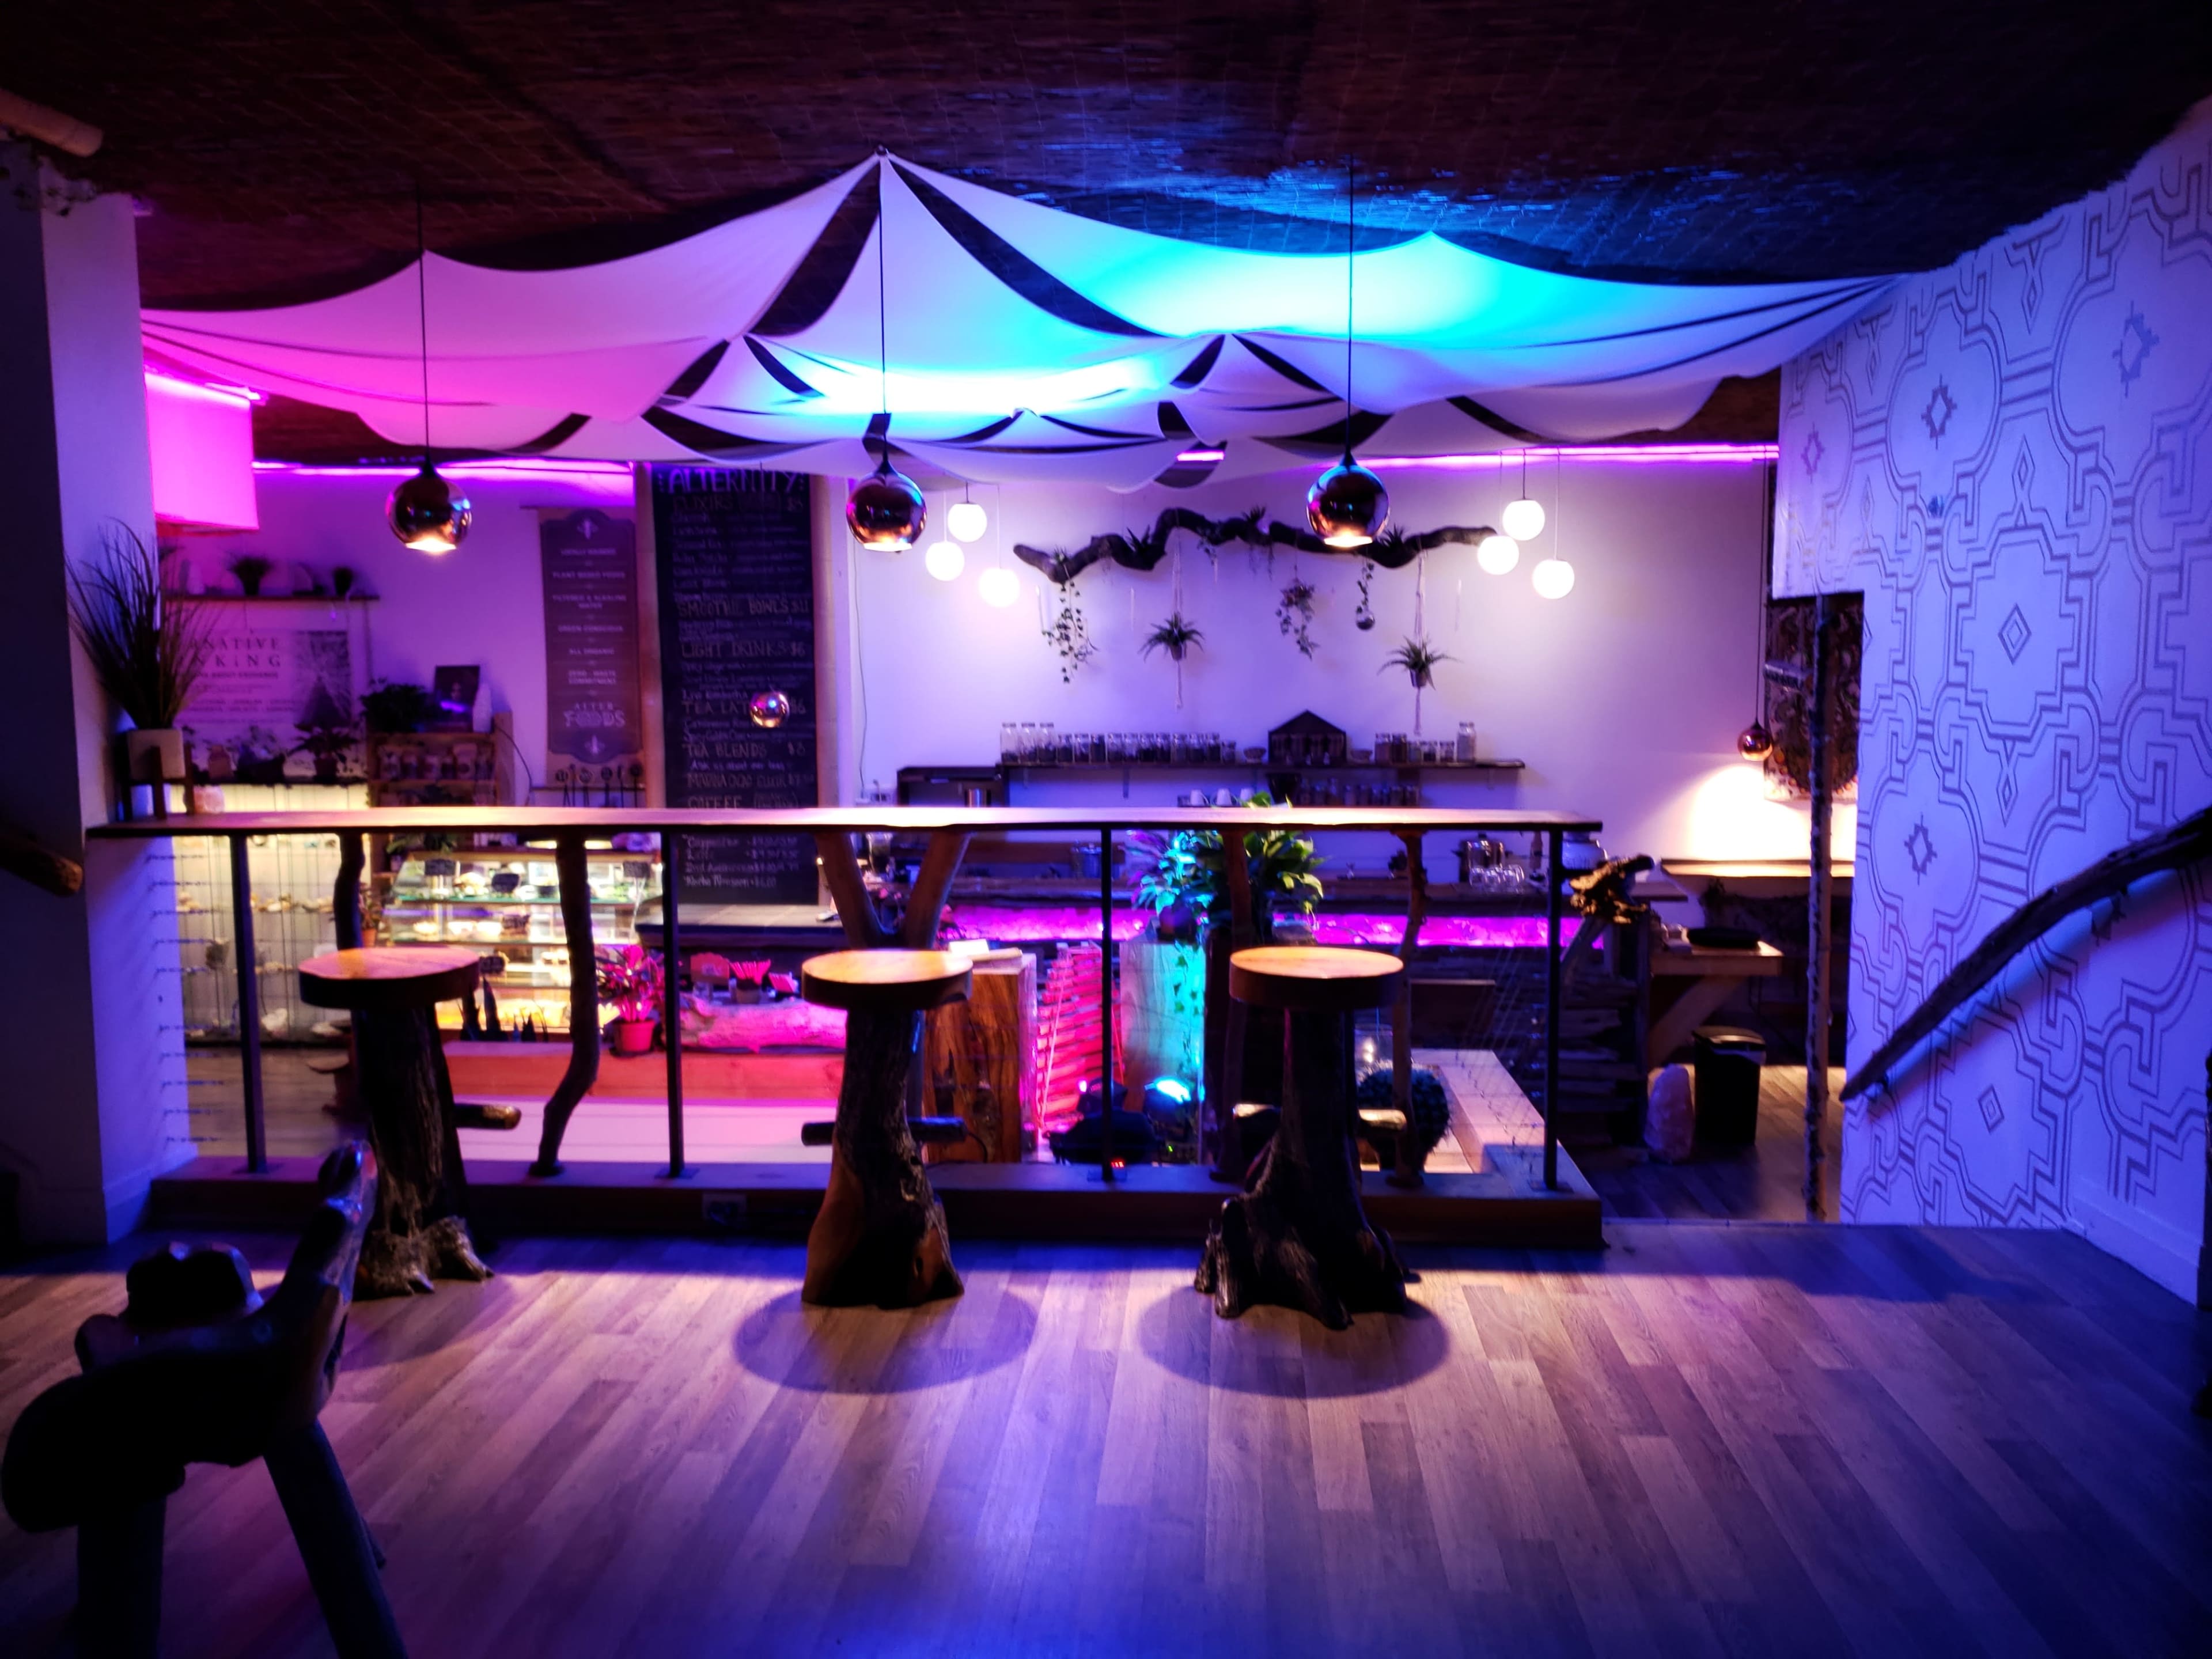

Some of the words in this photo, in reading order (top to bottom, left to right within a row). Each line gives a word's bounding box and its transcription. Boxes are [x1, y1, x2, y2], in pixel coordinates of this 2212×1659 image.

[668, 468, 796, 494] ALTERNITY
[748, 597, 789, 616] BOWLS
[681, 642, 722, 659] LIGHT
[731, 641, 787, 658] DRINKS
[681, 701, 714, 714] TEA
[715, 741, 767, 759] BLENDS
